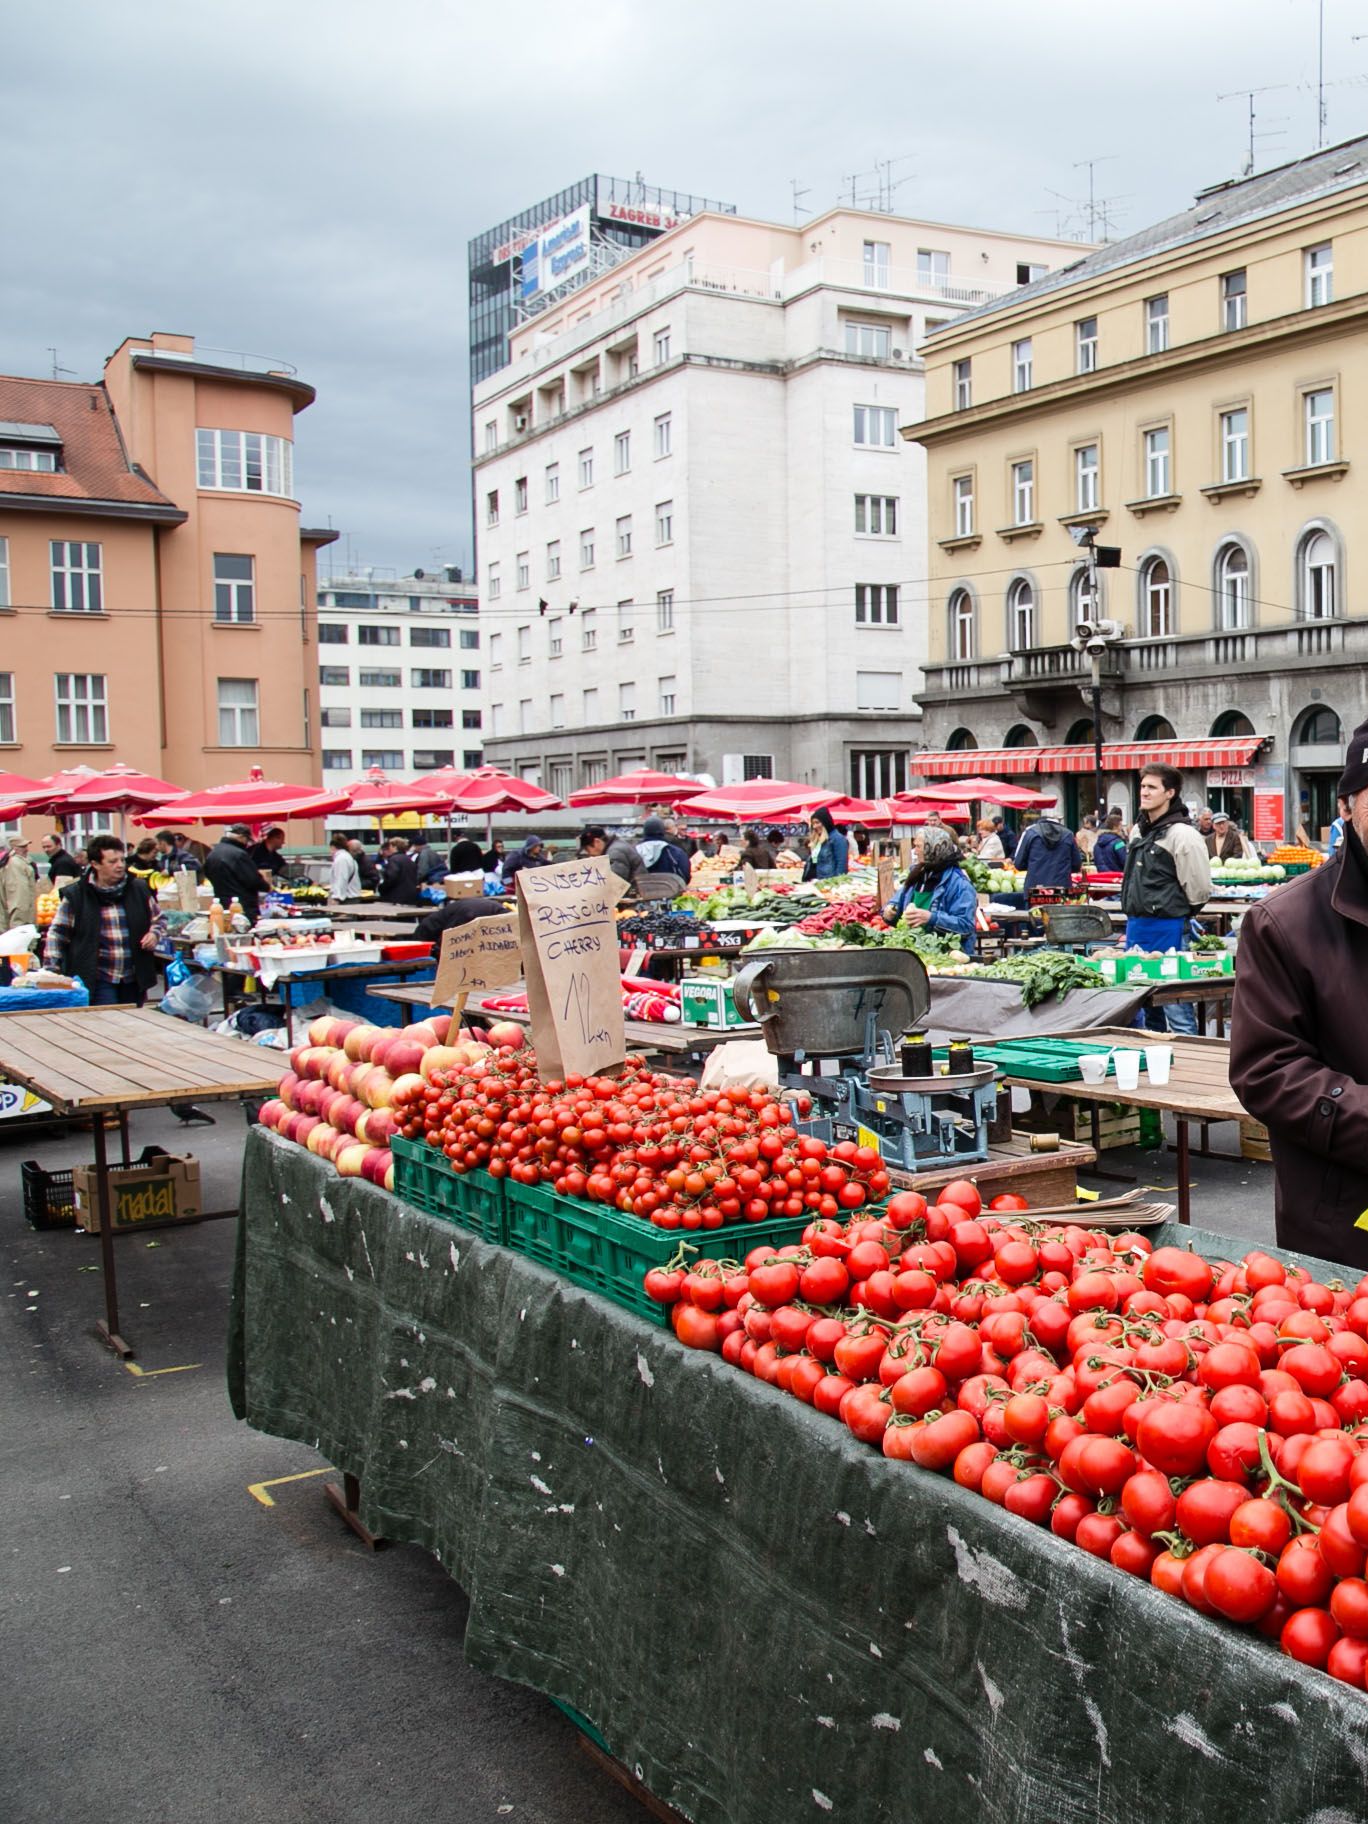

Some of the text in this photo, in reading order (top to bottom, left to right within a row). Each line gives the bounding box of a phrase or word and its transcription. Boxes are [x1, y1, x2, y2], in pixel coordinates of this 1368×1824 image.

[610, 204, 661, 227] ZAGREB
[1221, 770, 1243, 785] PIZZA
[529, 866, 607, 893] SVJEŽA
[537, 899, 610, 926] RAJČICA
[547, 936, 602, 960] CHERRY
[684, 985, 717, 1000] VEGORA
